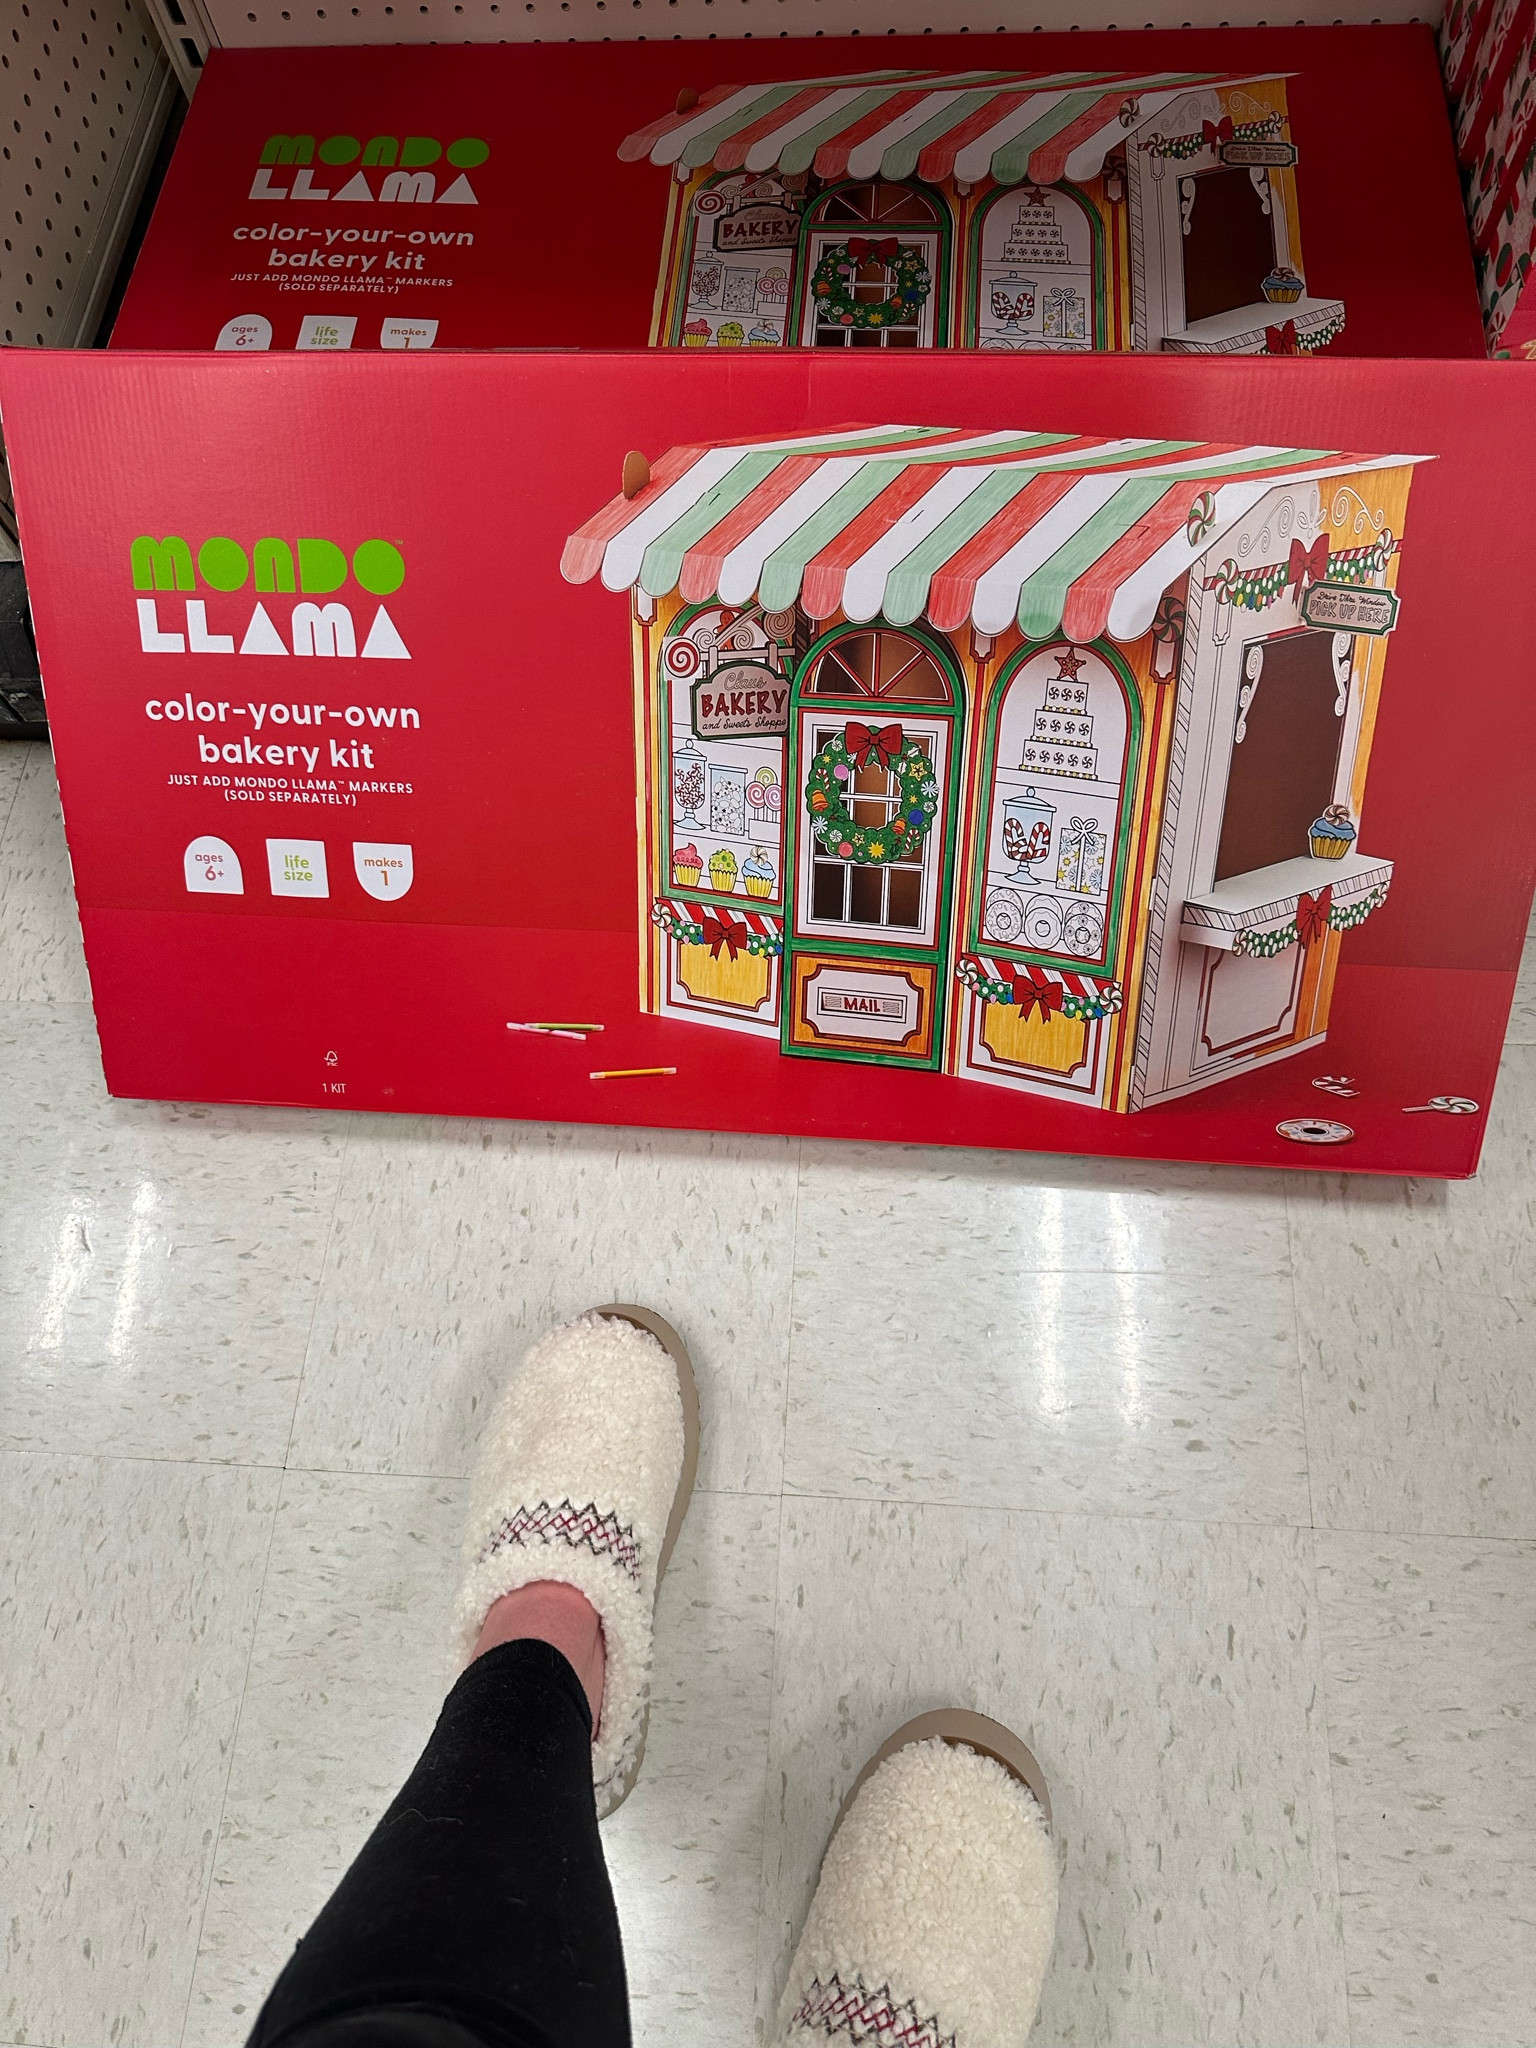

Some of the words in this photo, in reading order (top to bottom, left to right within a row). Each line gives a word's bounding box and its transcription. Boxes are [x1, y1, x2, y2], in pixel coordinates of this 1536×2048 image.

[259, 134, 490, 168] MONDO
[248, 168, 479, 204] LLAMA
[232, 222, 475, 246] color-your-own
[723, 220, 799, 238] BAKERY
[267, 248, 378, 272] bakery
[385, 251, 426, 270] kit
[230, 273, 260, 281] JUST
[262, 273, 289, 282] ADD
[291, 274, 340, 284] MONDO
[394, 277, 454, 287] MARKERS
[278, 282, 317, 292] (SOLD
[319, 283, 399, 295] SEPARATELY)
[231, 325, 258, 334] ages
[315, 326, 339, 338] life
[390, 327, 428, 337] makes
[235, 335, 255, 346] 6+
[310, 335, 339, 346] size
[403, 337, 411, 348] 1
[1358, 595, 1388, 607] Window
[1308, 600, 1337, 618] PICK
[1338, 603, 1357, 620] UP
[1357, 605, 1391, 624] HERE
[136, 598, 413, 660] LLAMA
[145, 692, 421, 730] color-your-own
[701, 689, 788, 718] BAKERY
[702, 719, 721, 730] and
[723, 718, 752, 729] Sweets
[755, 716, 787, 730] Shoppe
[197, 734, 320, 774] bakery
[329, 738, 375, 770] kit
[167, 774, 198, 787] JUST
[202, 775, 231, 788] ADD
[234, 776, 288, 790] MONDO
[348, 781, 414, 795] MARKERS
[223, 790, 265, 803] (SOLD
[268, 792, 357, 807] SEPARATELY)
[194, 853, 223, 864] ages
[284, 854, 310, 870] life
[363, 856, 404, 869] makes
[205, 866, 225, 881] 6+
[283, 867, 314, 882] size
[380, 870, 389, 886] 1
[843, 996, 882, 1013] MAIL
[322, 1082, 328, 1093] 1
[330, 1083, 347, 1094] KIT
